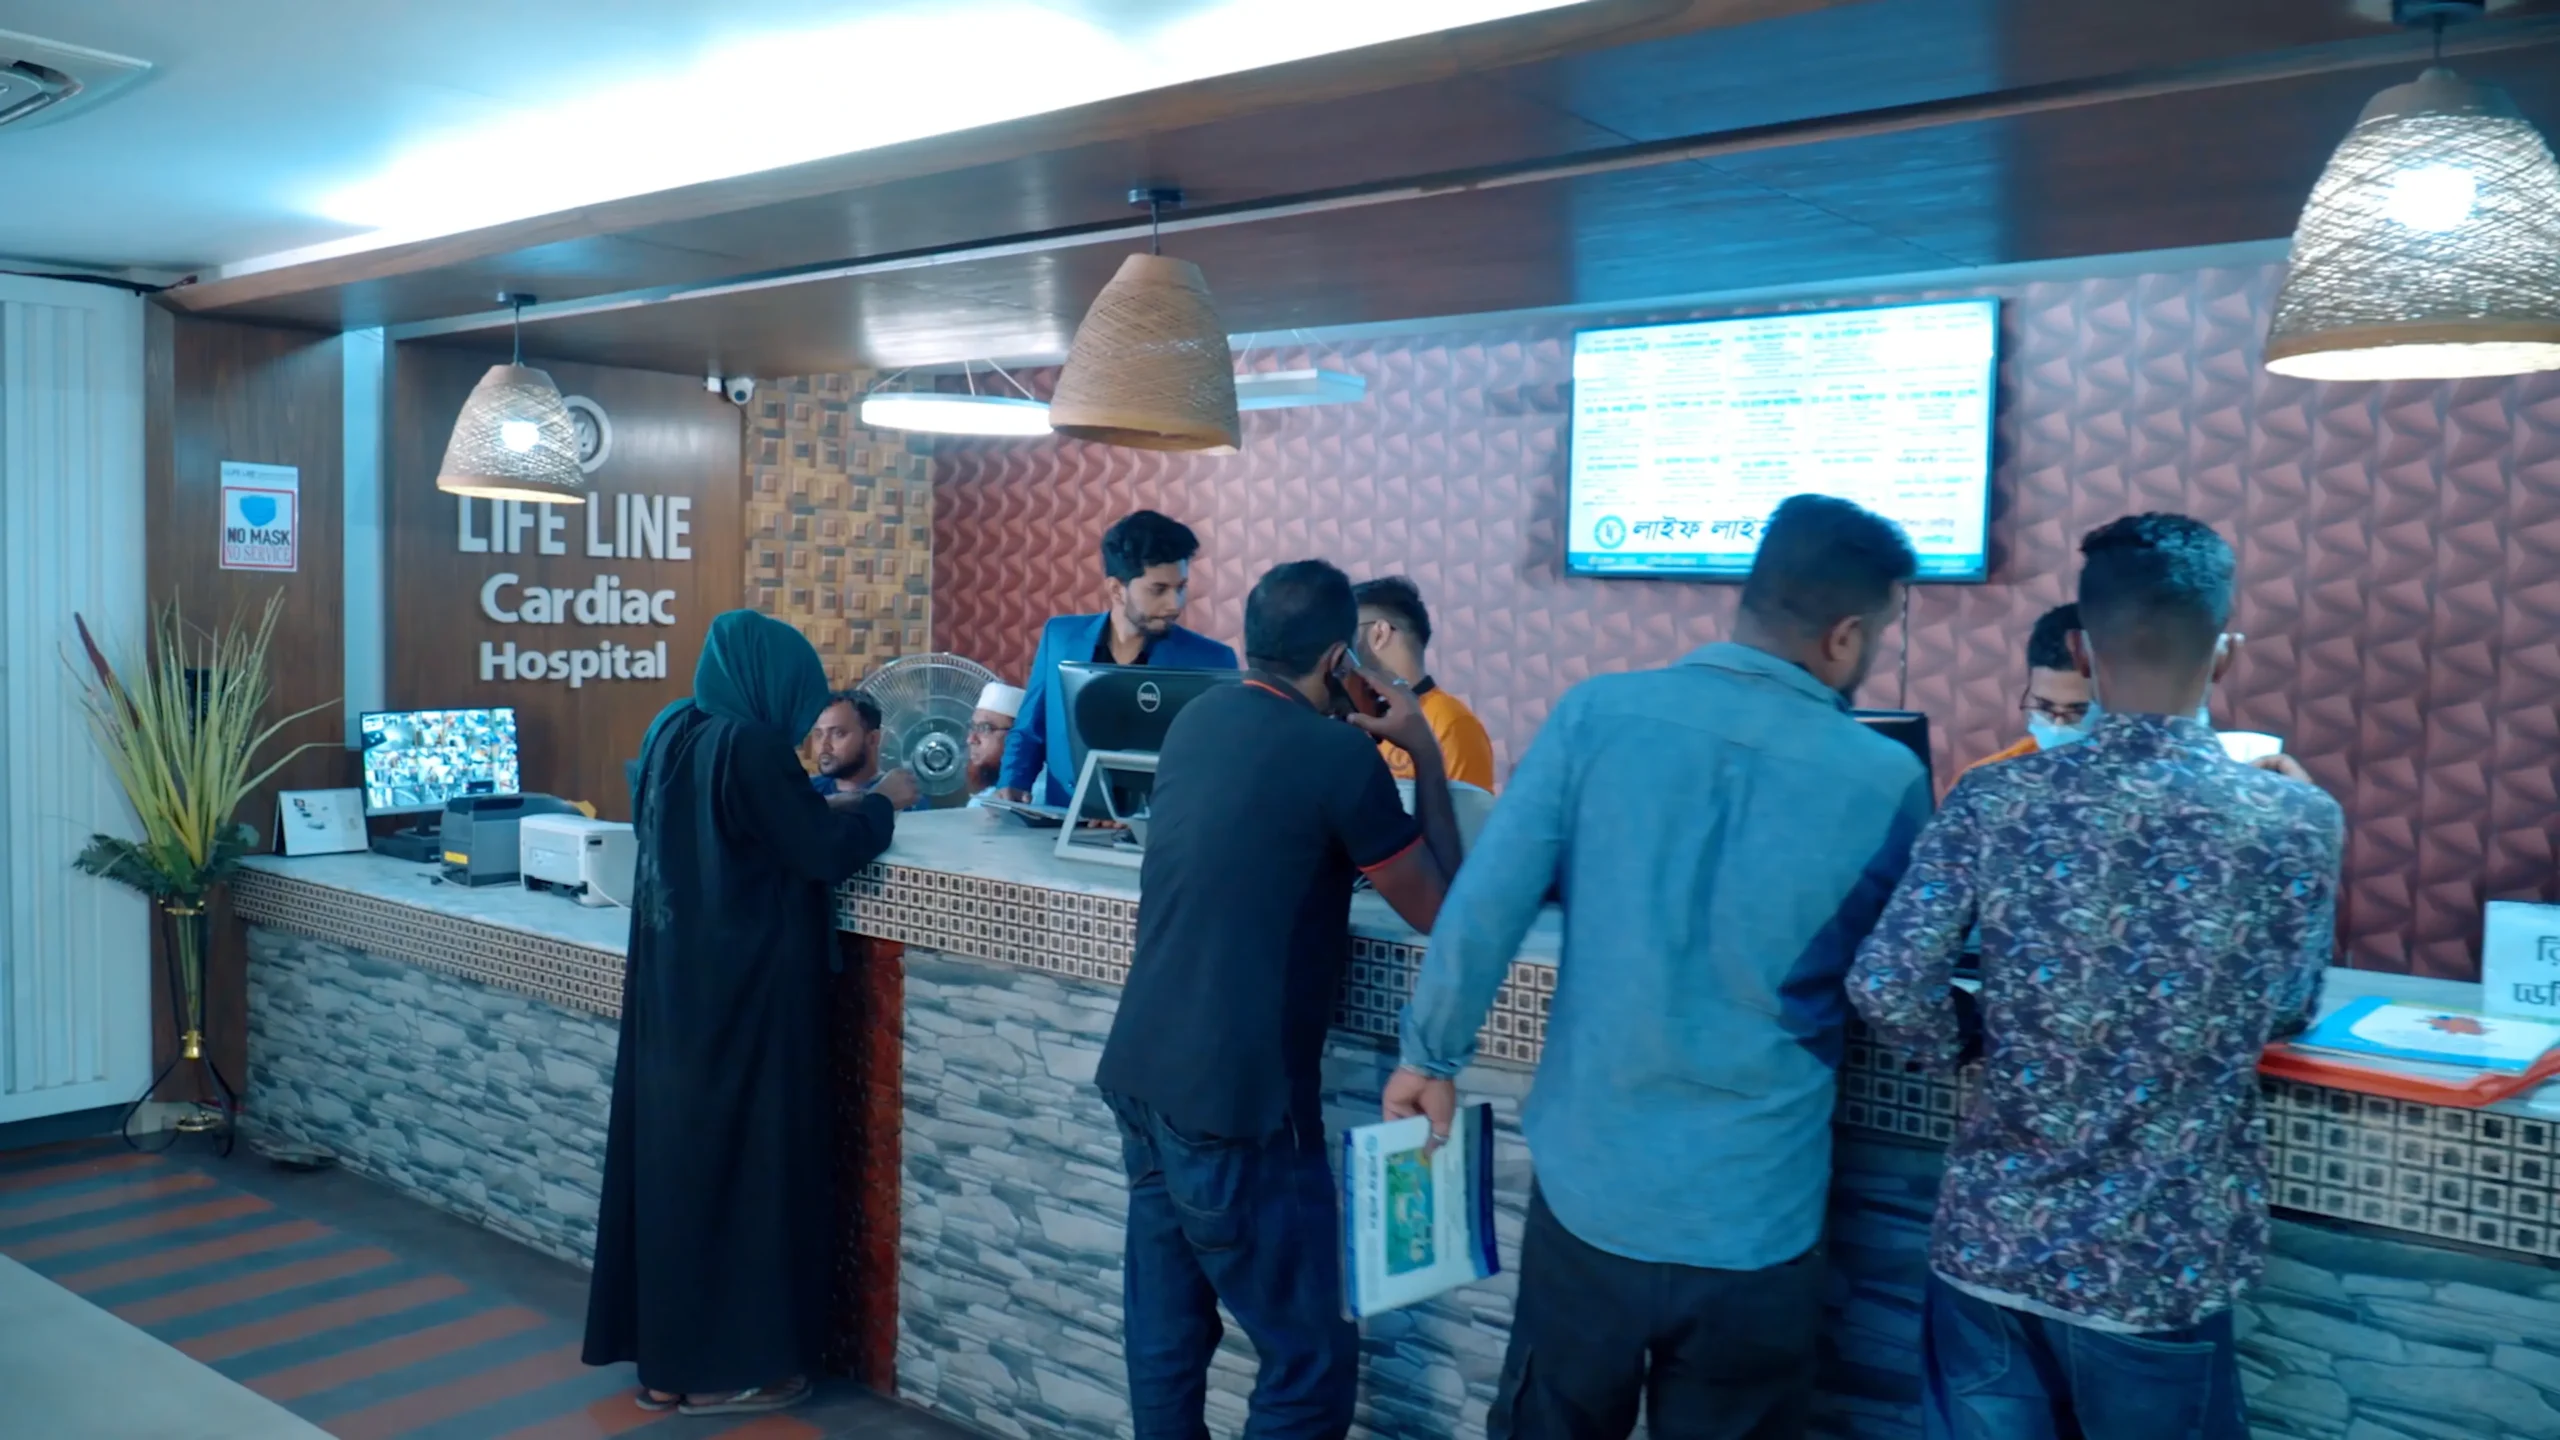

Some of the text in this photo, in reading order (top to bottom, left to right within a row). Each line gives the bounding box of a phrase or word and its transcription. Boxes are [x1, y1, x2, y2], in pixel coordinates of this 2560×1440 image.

[227, 527, 290, 546] NO MASK
[458, 491, 691, 560] LIFE LINE
[1633, 515, 1770, 540] লাইফ লাই
[480, 573, 676, 625] Cardiac
[480, 641, 667, 688] Hospital
